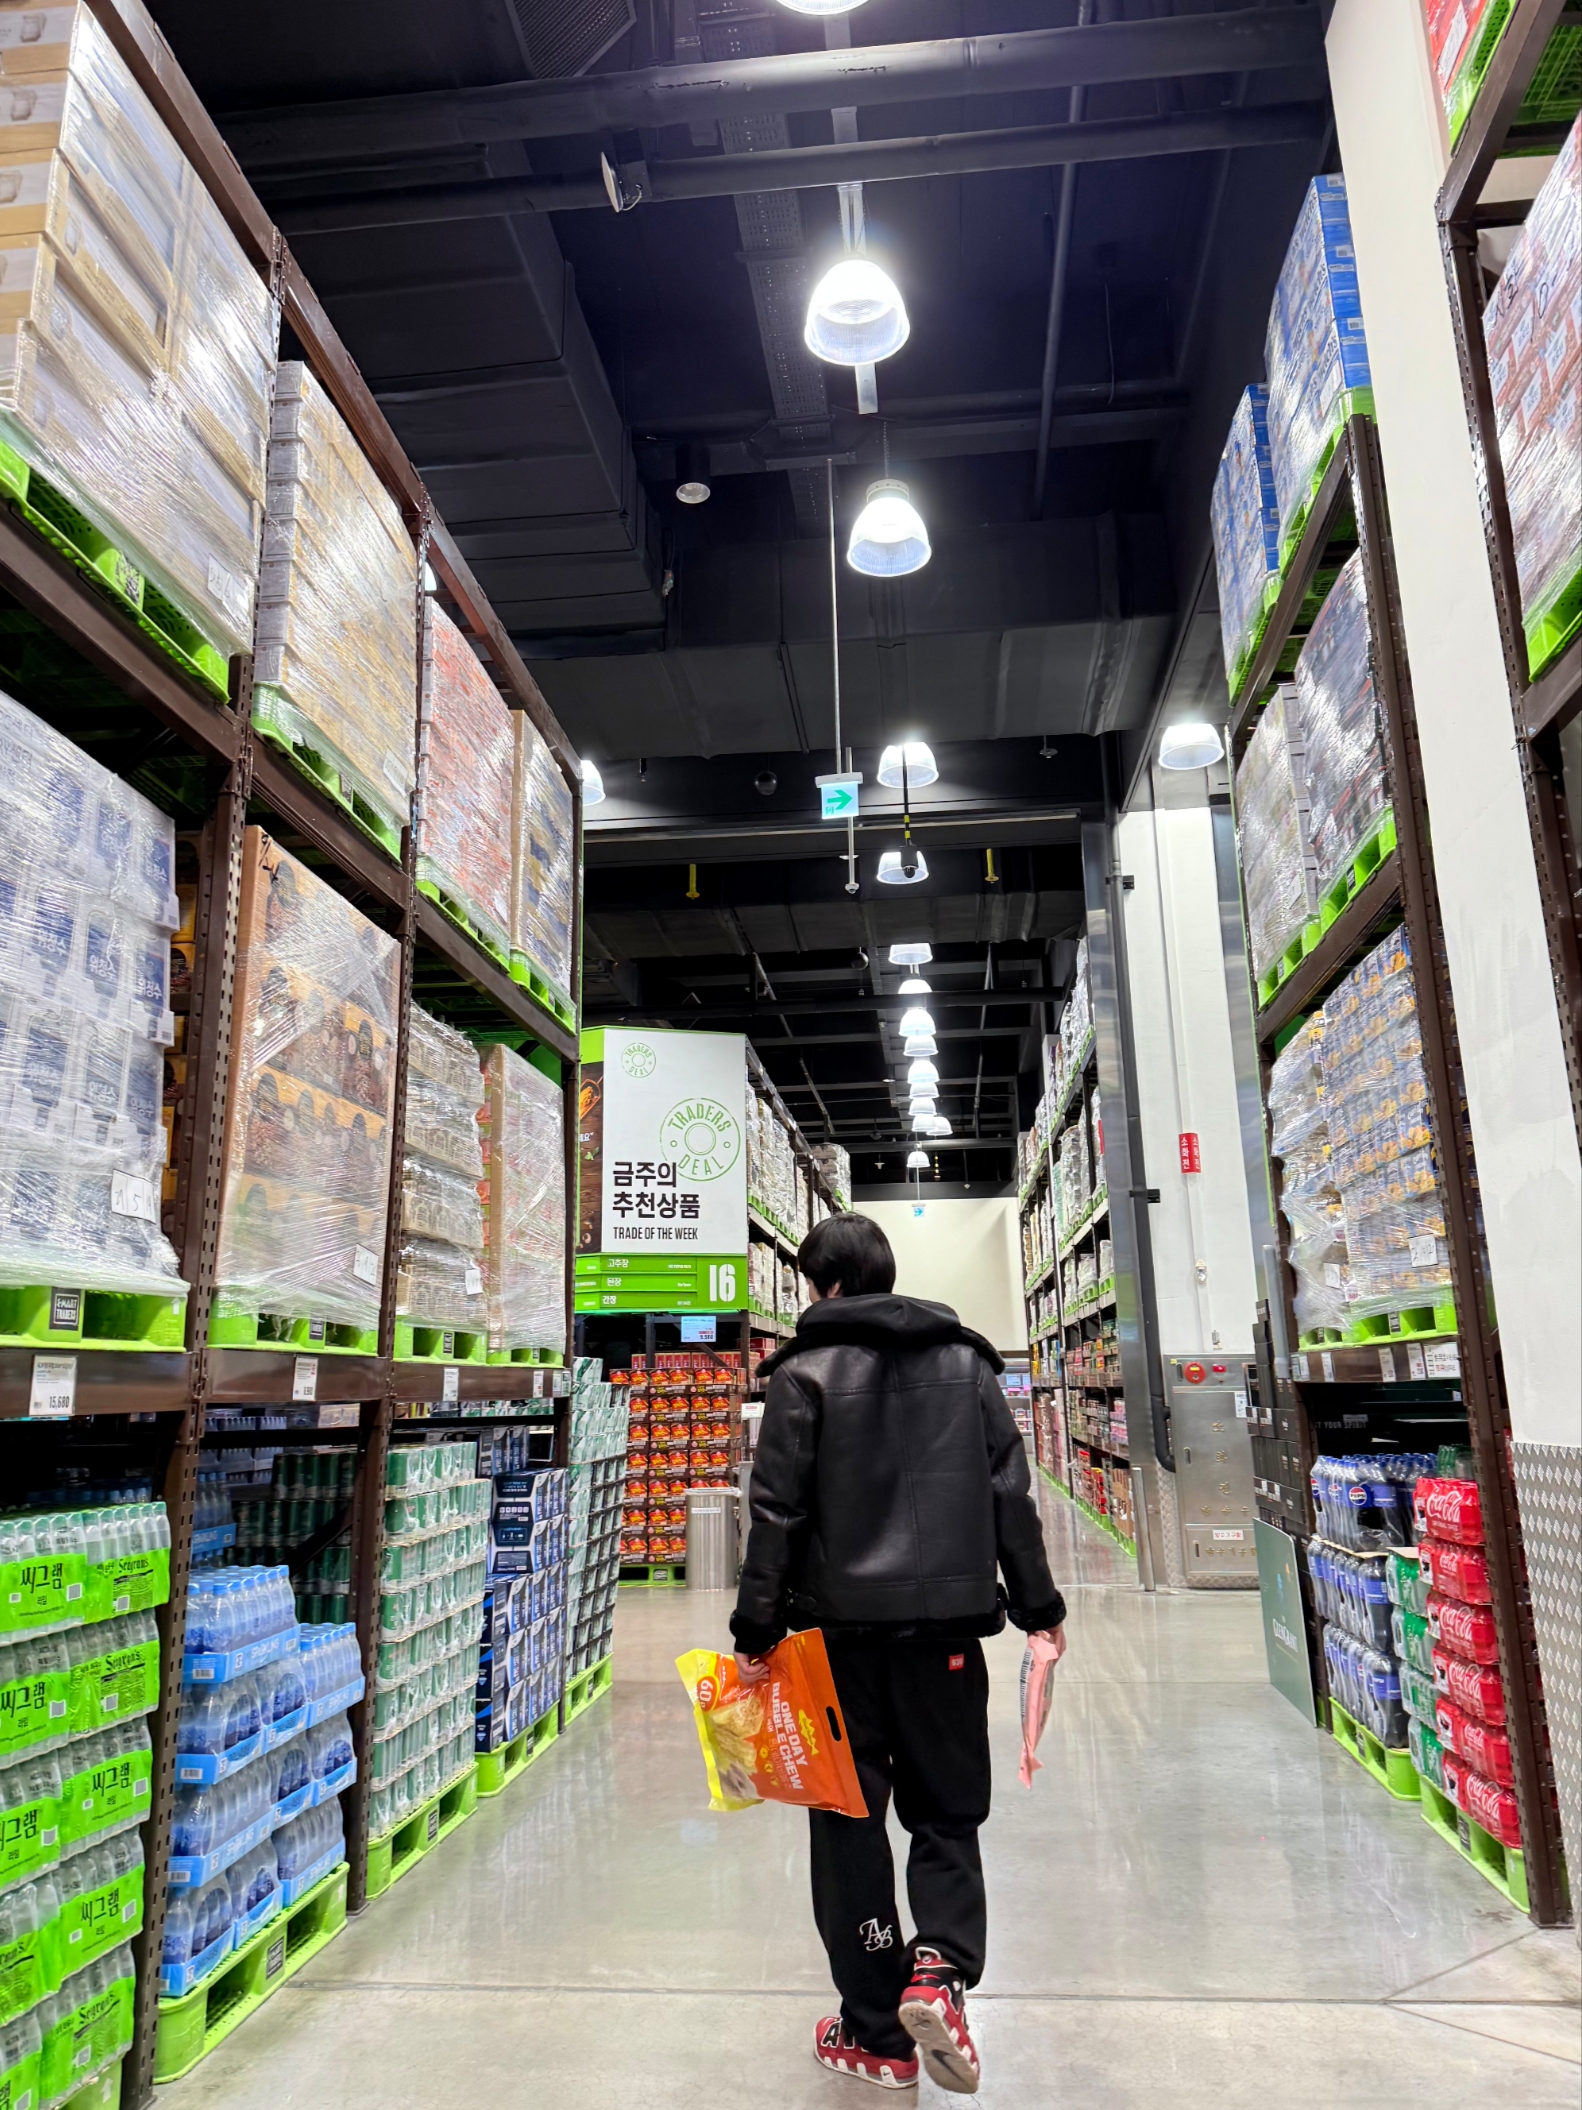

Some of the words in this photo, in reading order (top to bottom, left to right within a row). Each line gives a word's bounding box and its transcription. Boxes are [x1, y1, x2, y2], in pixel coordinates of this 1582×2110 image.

[625, 1045, 652, 1058] TRADERS
[628, 1066, 649, 1076] DEAL
[668, 1103, 732, 1132] TRADERS
[678, 1153, 724, 1175] DEAL
[1181, 1136, 1190, 1170] 소화전
[613, 1161, 677, 1188] 금주의
[612, 1191, 700, 1219] 추천상품
[613, 1226, 643, 1239] TRADE
[644, 1227, 655, 1239] OF
[657, 1227, 672, 1239] THE
[674, 1227, 698, 1240] WEEK
[607, 1259, 629, 1268] 고추장
[709, 1264, 736, 1303] 16
[1349, 1492, 1367, 1500] PEPSI
[20, 1562, 64, 1594] 씨그램
[772, 1681, 788, 1745] BUBBLE
[780, 1700, 797, 1737] ONE
[778, 1742, 805, 1790] CHEW
[788, 1735, 809, 1767] DAY
[92, 1762, 131, 1797] 씨그램
[81, 1887, 120, 1928] 씨그램
